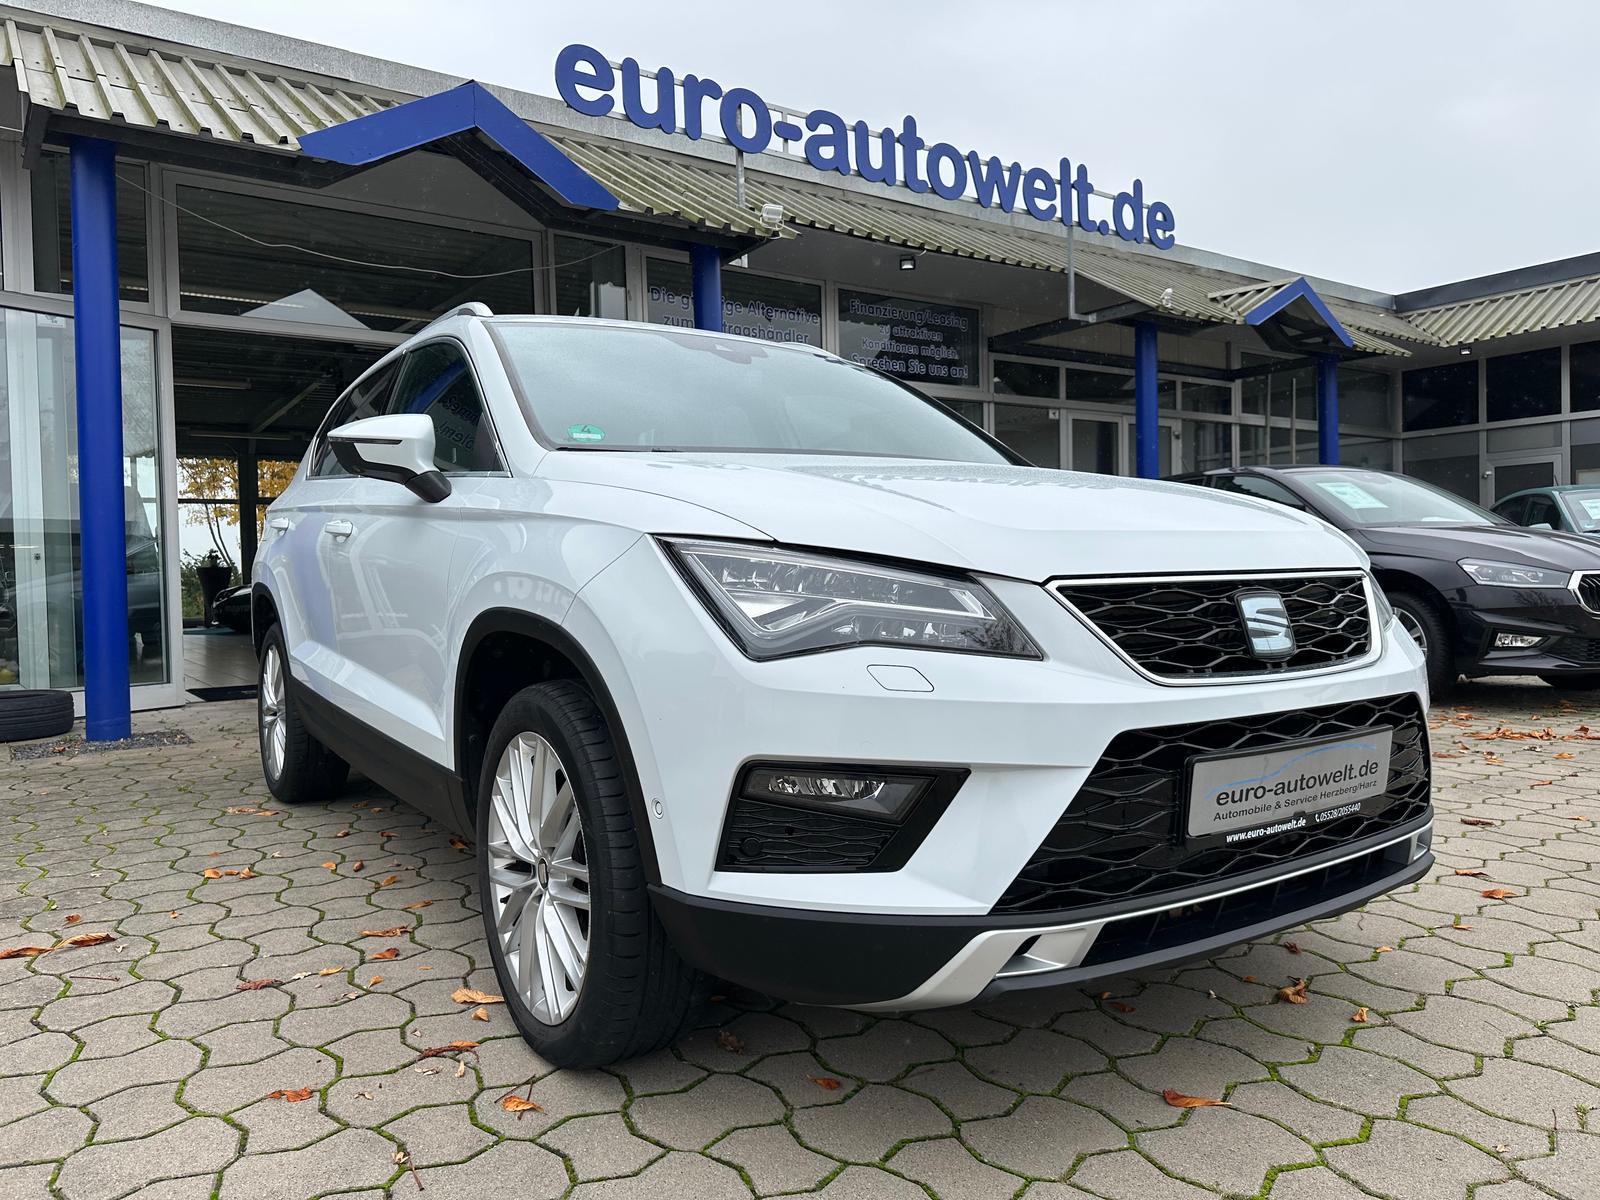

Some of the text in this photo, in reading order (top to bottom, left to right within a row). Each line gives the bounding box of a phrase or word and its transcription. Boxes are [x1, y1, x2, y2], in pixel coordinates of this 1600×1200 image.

[555, 43, 1175, 250] euro-autowelt.de
[649, 287, 676, 304] Die
[747, 300, 820, 325] Alternative
[849, 298, 969, 332] Finanzierung/Leasing
[862, 337, 919, 356] Konditionen
[879, 324, 944, 342] zu attraktiven
[850, 352, 969, 379] Sprechen Sie uns an!
[1216, 759, 1379, 806] euro-autowelt.de
[1213, 779, 1377, 822] Automobile & Service Herzberg/Harz
[1226, 817, 1307, 843] www.euro-autowelt.de
